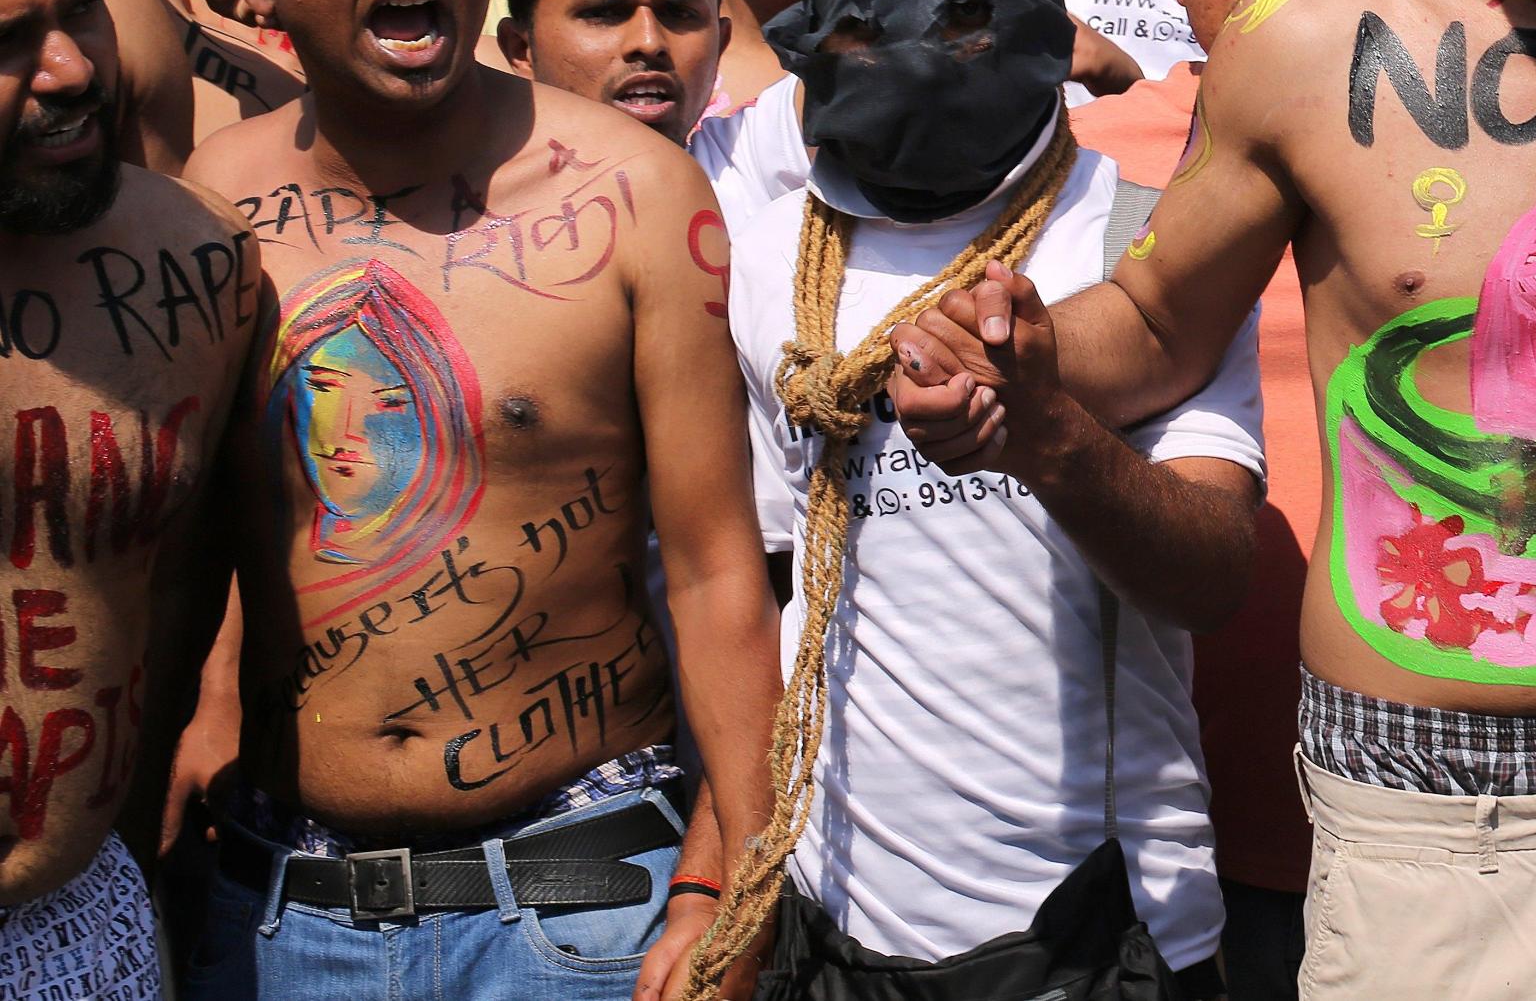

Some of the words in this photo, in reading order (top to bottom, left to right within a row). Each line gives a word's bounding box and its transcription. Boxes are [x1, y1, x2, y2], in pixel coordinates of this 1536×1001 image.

[1087, 15, 1128, 36] Call
[77, 230, 258, 362] RAPE
[383, 590, 628, 722] HER
